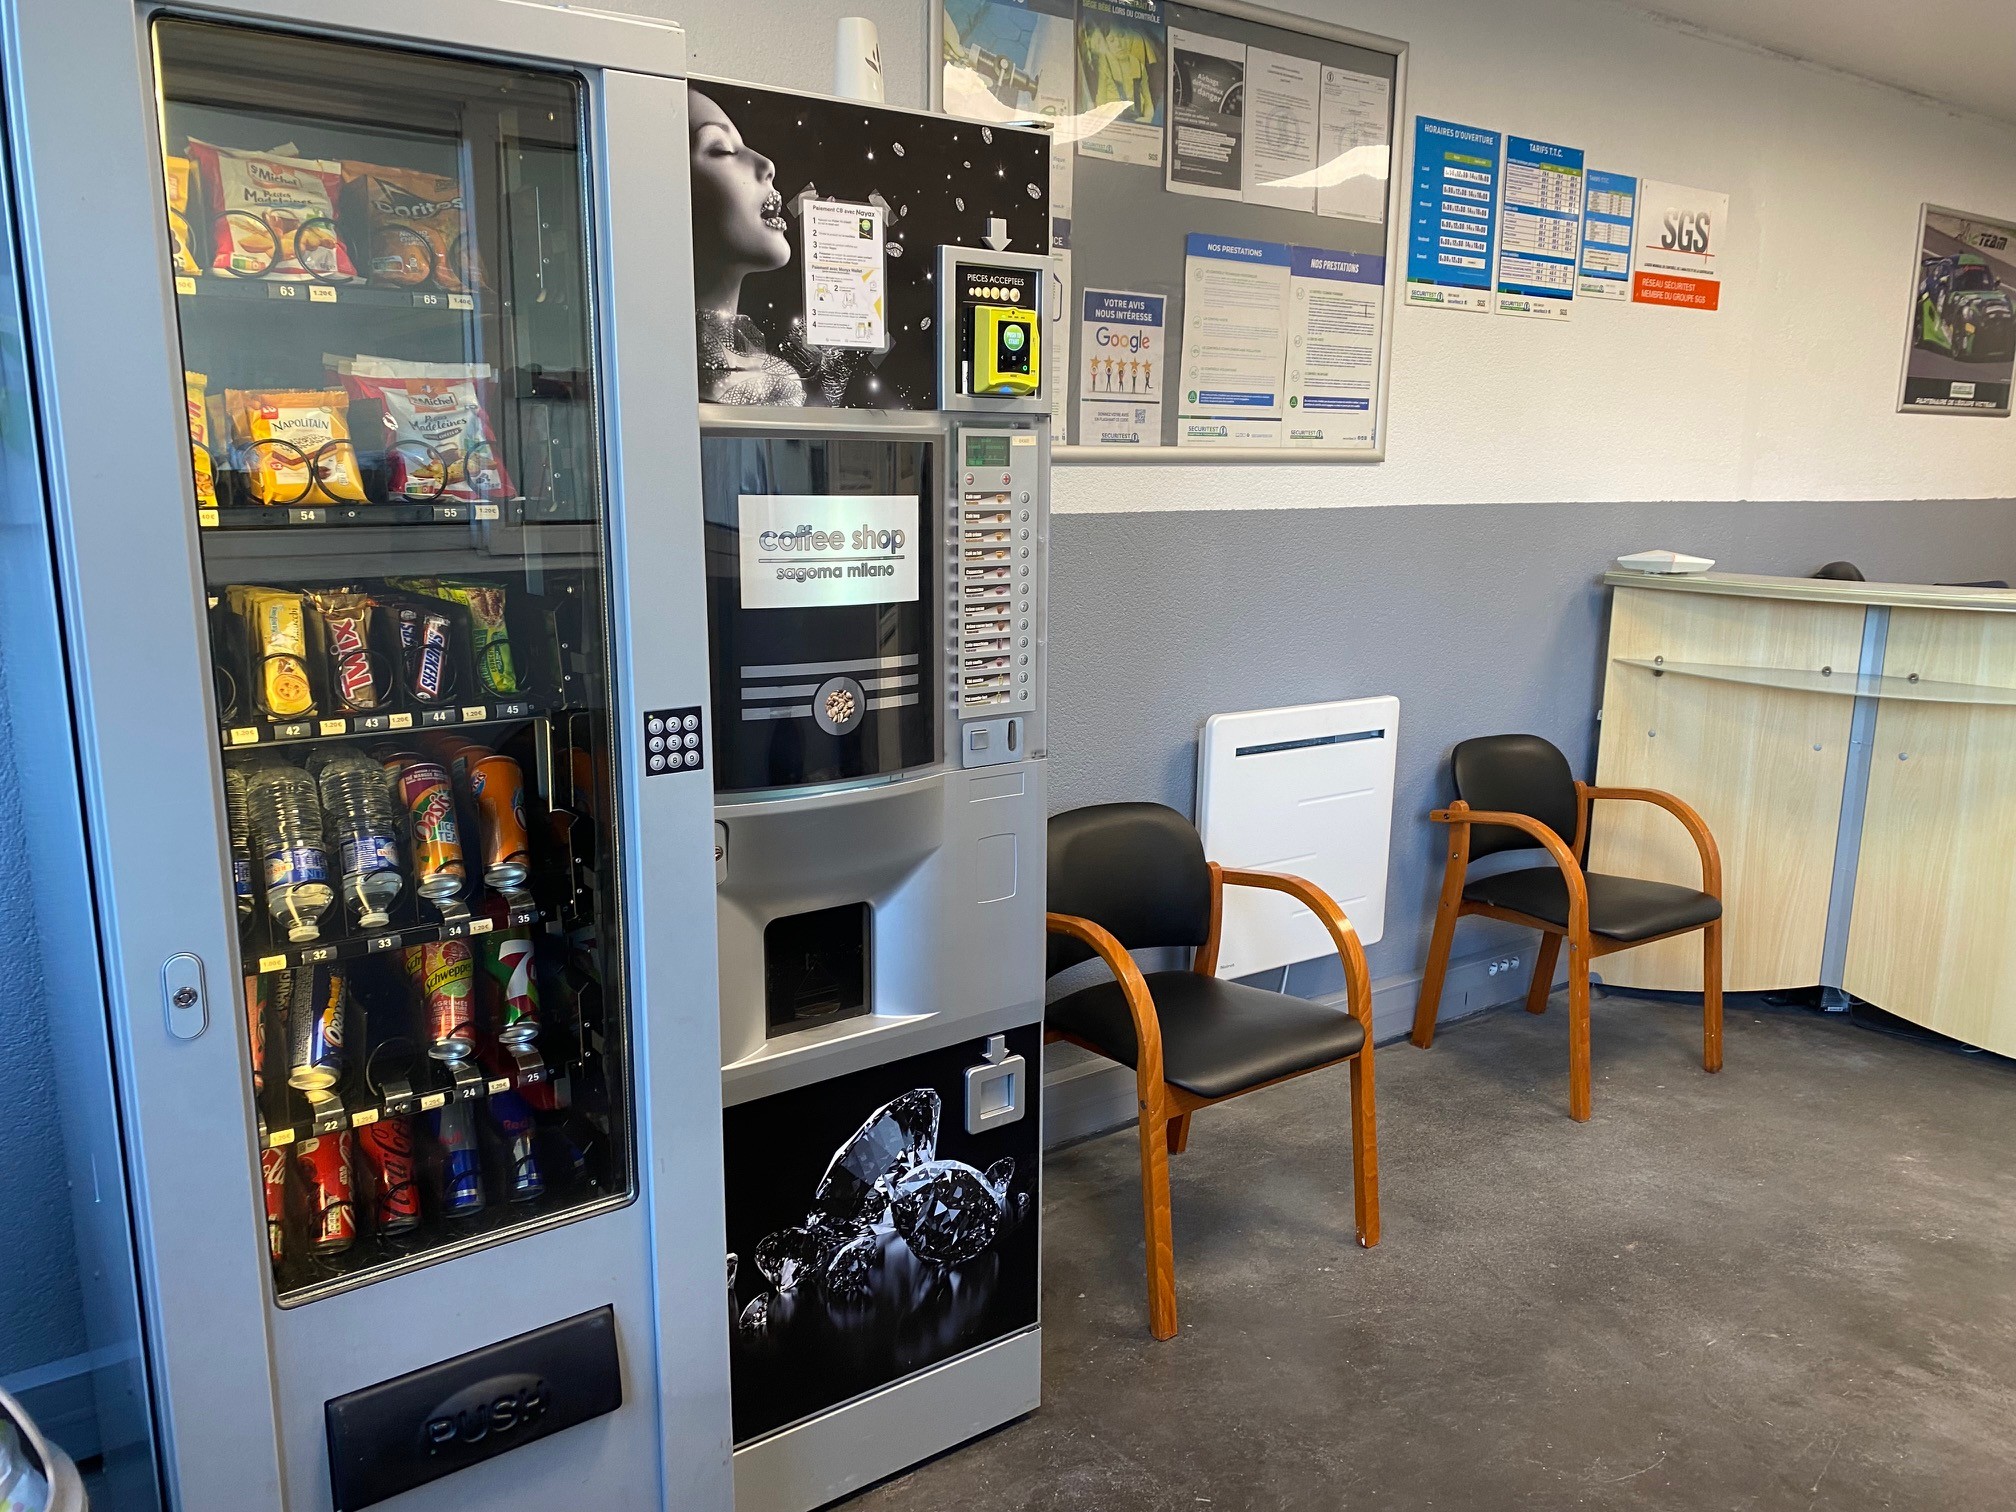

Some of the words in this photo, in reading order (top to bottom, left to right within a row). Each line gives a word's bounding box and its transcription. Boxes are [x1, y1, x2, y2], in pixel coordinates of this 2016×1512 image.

[1112, 6, 1126, 16] LORS
[1126, 10, 1134, 18] DU
[1134, 11, 1160, 24] CONTRÔLE
[1424, 124, 1454, 138] HORAIRES
[1454, 130, 1494, 145] D'OUVERTURE
[1530, 144, 1548, 154] TARIFS
[1549, 148, 1564, 158] T.T.C.
[259, 168, 297, 186] Michel
[263, 190, 291, 198] Petites
[374, 197, 463, 216] Doritos
[1661, 206, 1710, 254] SGS
[1208, 244, 1221, 252] NOS
[1222, 246, 1262, 257] PRESTATIONS
[1310, 258, 1322, 269] NOS
[1323, 260, 1359, 273] PRESTATIONS
[967, 274, 988, 282] PIECES
[990, 276, 1024, 286] ACCEPTEES
[280, 286, 295, 296] 63
[1641, 290, 1664, 299] MEMBRE
[1664, 292, 1672, 300] DU
[1672, 292, 1694, 303] GROUPE
[1695, 295, 1706, 304] SGS
[424, 295, 437, 305] 65
[1104, 298, 1127, 308] VOTRE
[1128, 301, 1145, 310] AVIS
[1095, 309, 1115, 318] NOUS
[1116, 310, 1152, 322] INTÉRESSE
[1096, 326, 1150, 353] Google
[420, 396, 454, 406] Michel
[271, 418, 329, 432] NAPOLITAIN
[409, 418, 467, 431] Madeleines
[300, 511, 315, 521] 54
[444, 508, 457, 518] 55
[759, 525, 845, 551] coffee
[852, 524, 905, 554] shop
[776, 565, 842, 582] sagoma
[847, 562, 894, 578] milano
[420, 630, 444, 692] SNICKERS
[506, 705, 519, 714] 45
[433, 712, 446, 721] 44
[365, 718, 379, 728] 43
[286, 726, 300, 735] 42
[415, 794, 452, 840] Oasis
[518, 914, 530, 923] 35
[449, 926, 462, 936] 34
[378, 938, 392, 948] 33
[313, 950, 327, 960] 32
[527, 1073, 540, 1082] 25
[463, 1088, 475, 1098] 24
[324, 1121, 338, 1131] 22
[427, 1379, 547, 1456] PUSH
